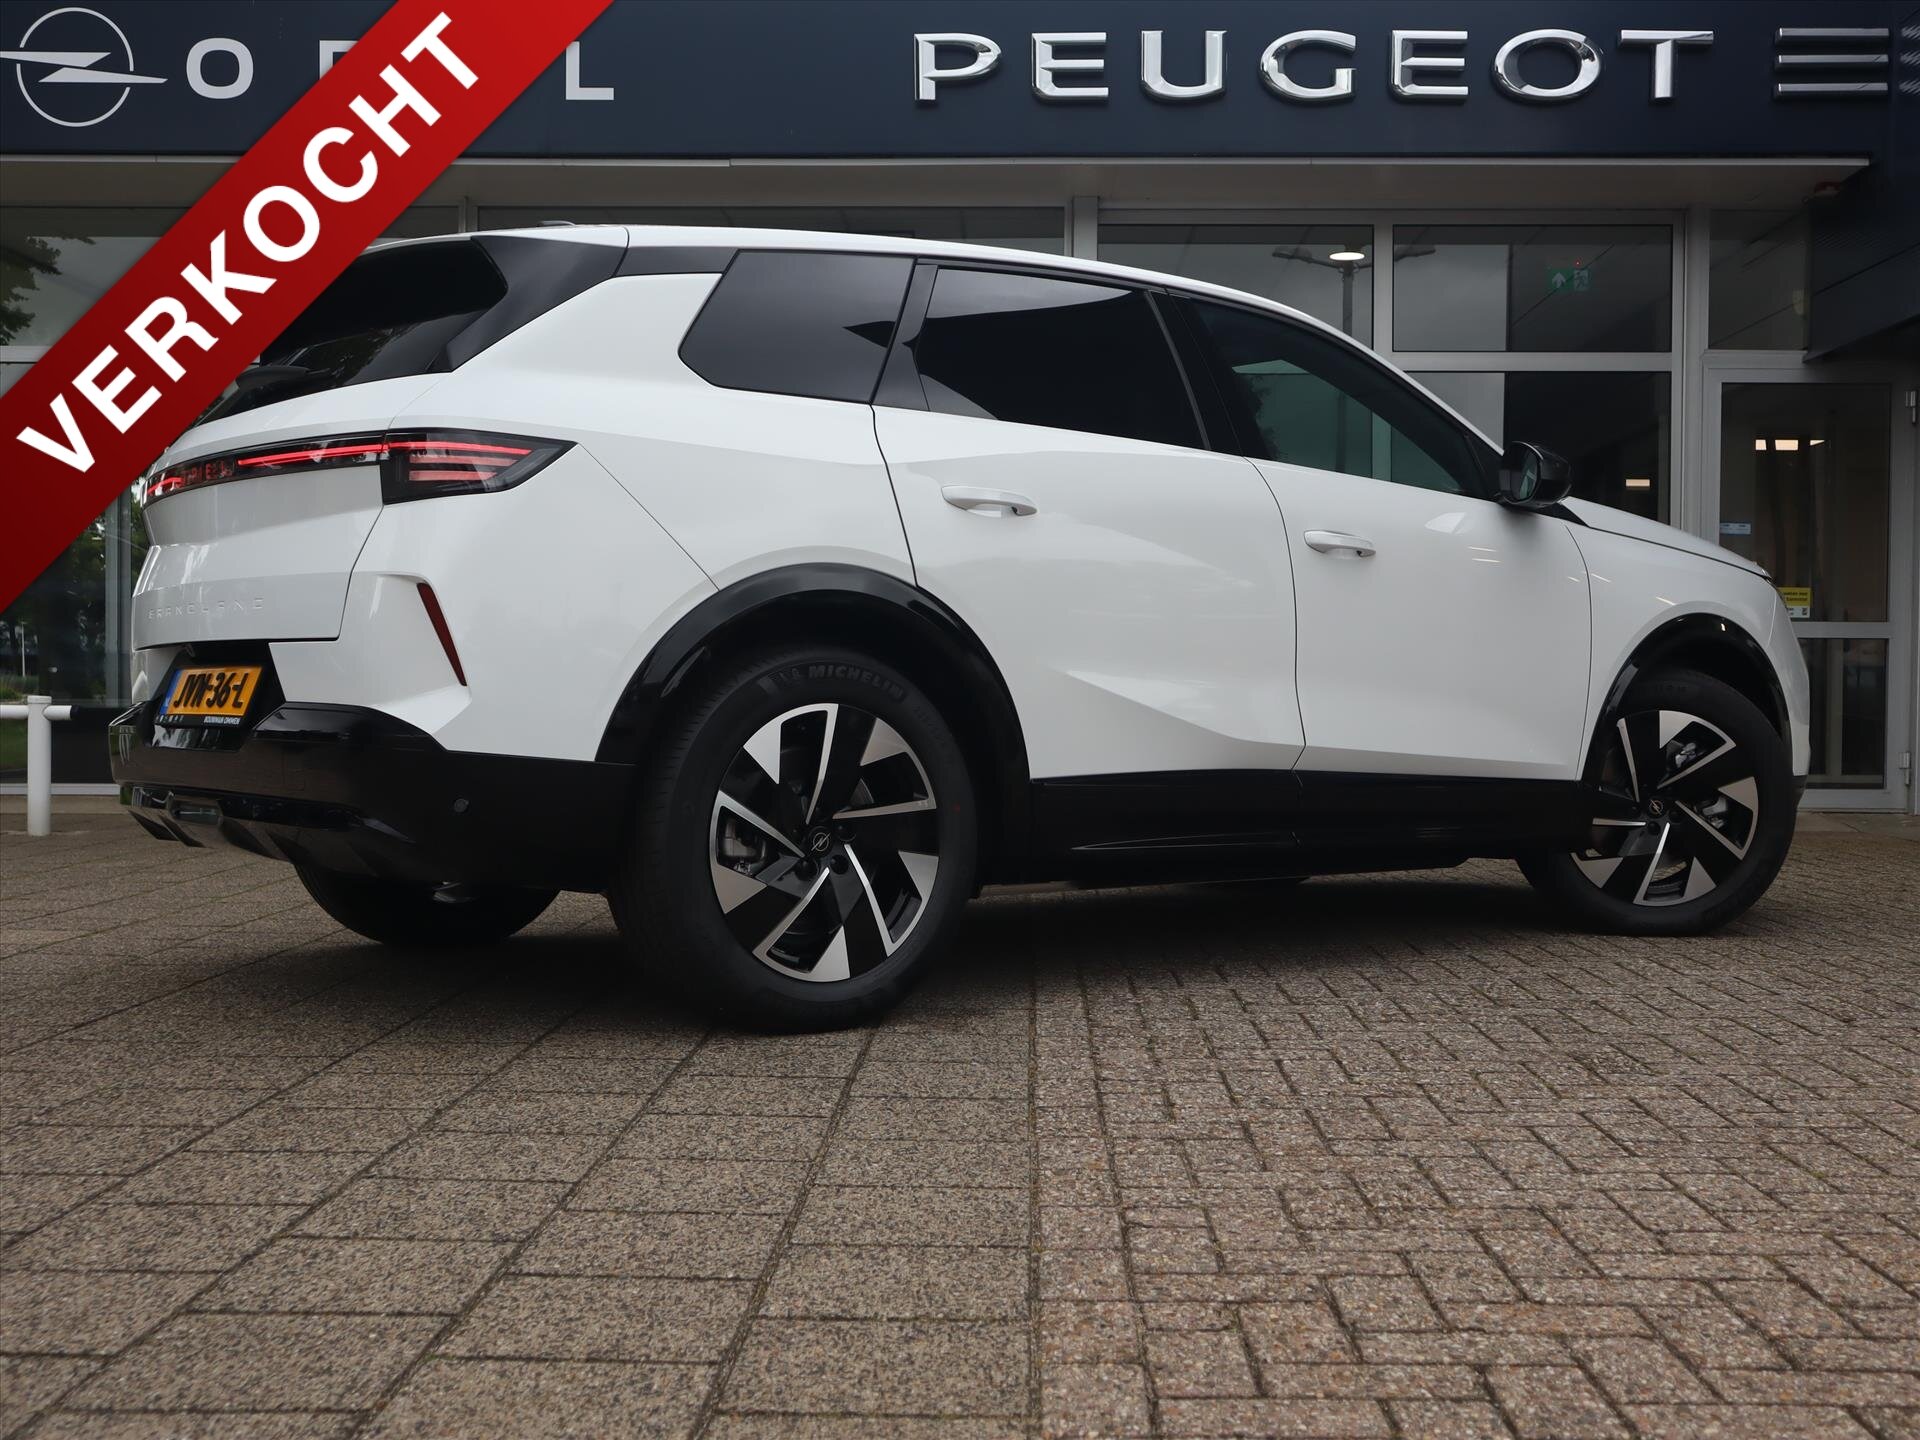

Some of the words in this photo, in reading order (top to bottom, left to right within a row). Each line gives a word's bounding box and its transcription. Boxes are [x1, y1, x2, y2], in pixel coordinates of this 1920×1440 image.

[186, 38, 615, 100] OL
[914, 29, 1714, 103] PEUGEOT
[808, 664, 905, 700] MICHELIN
